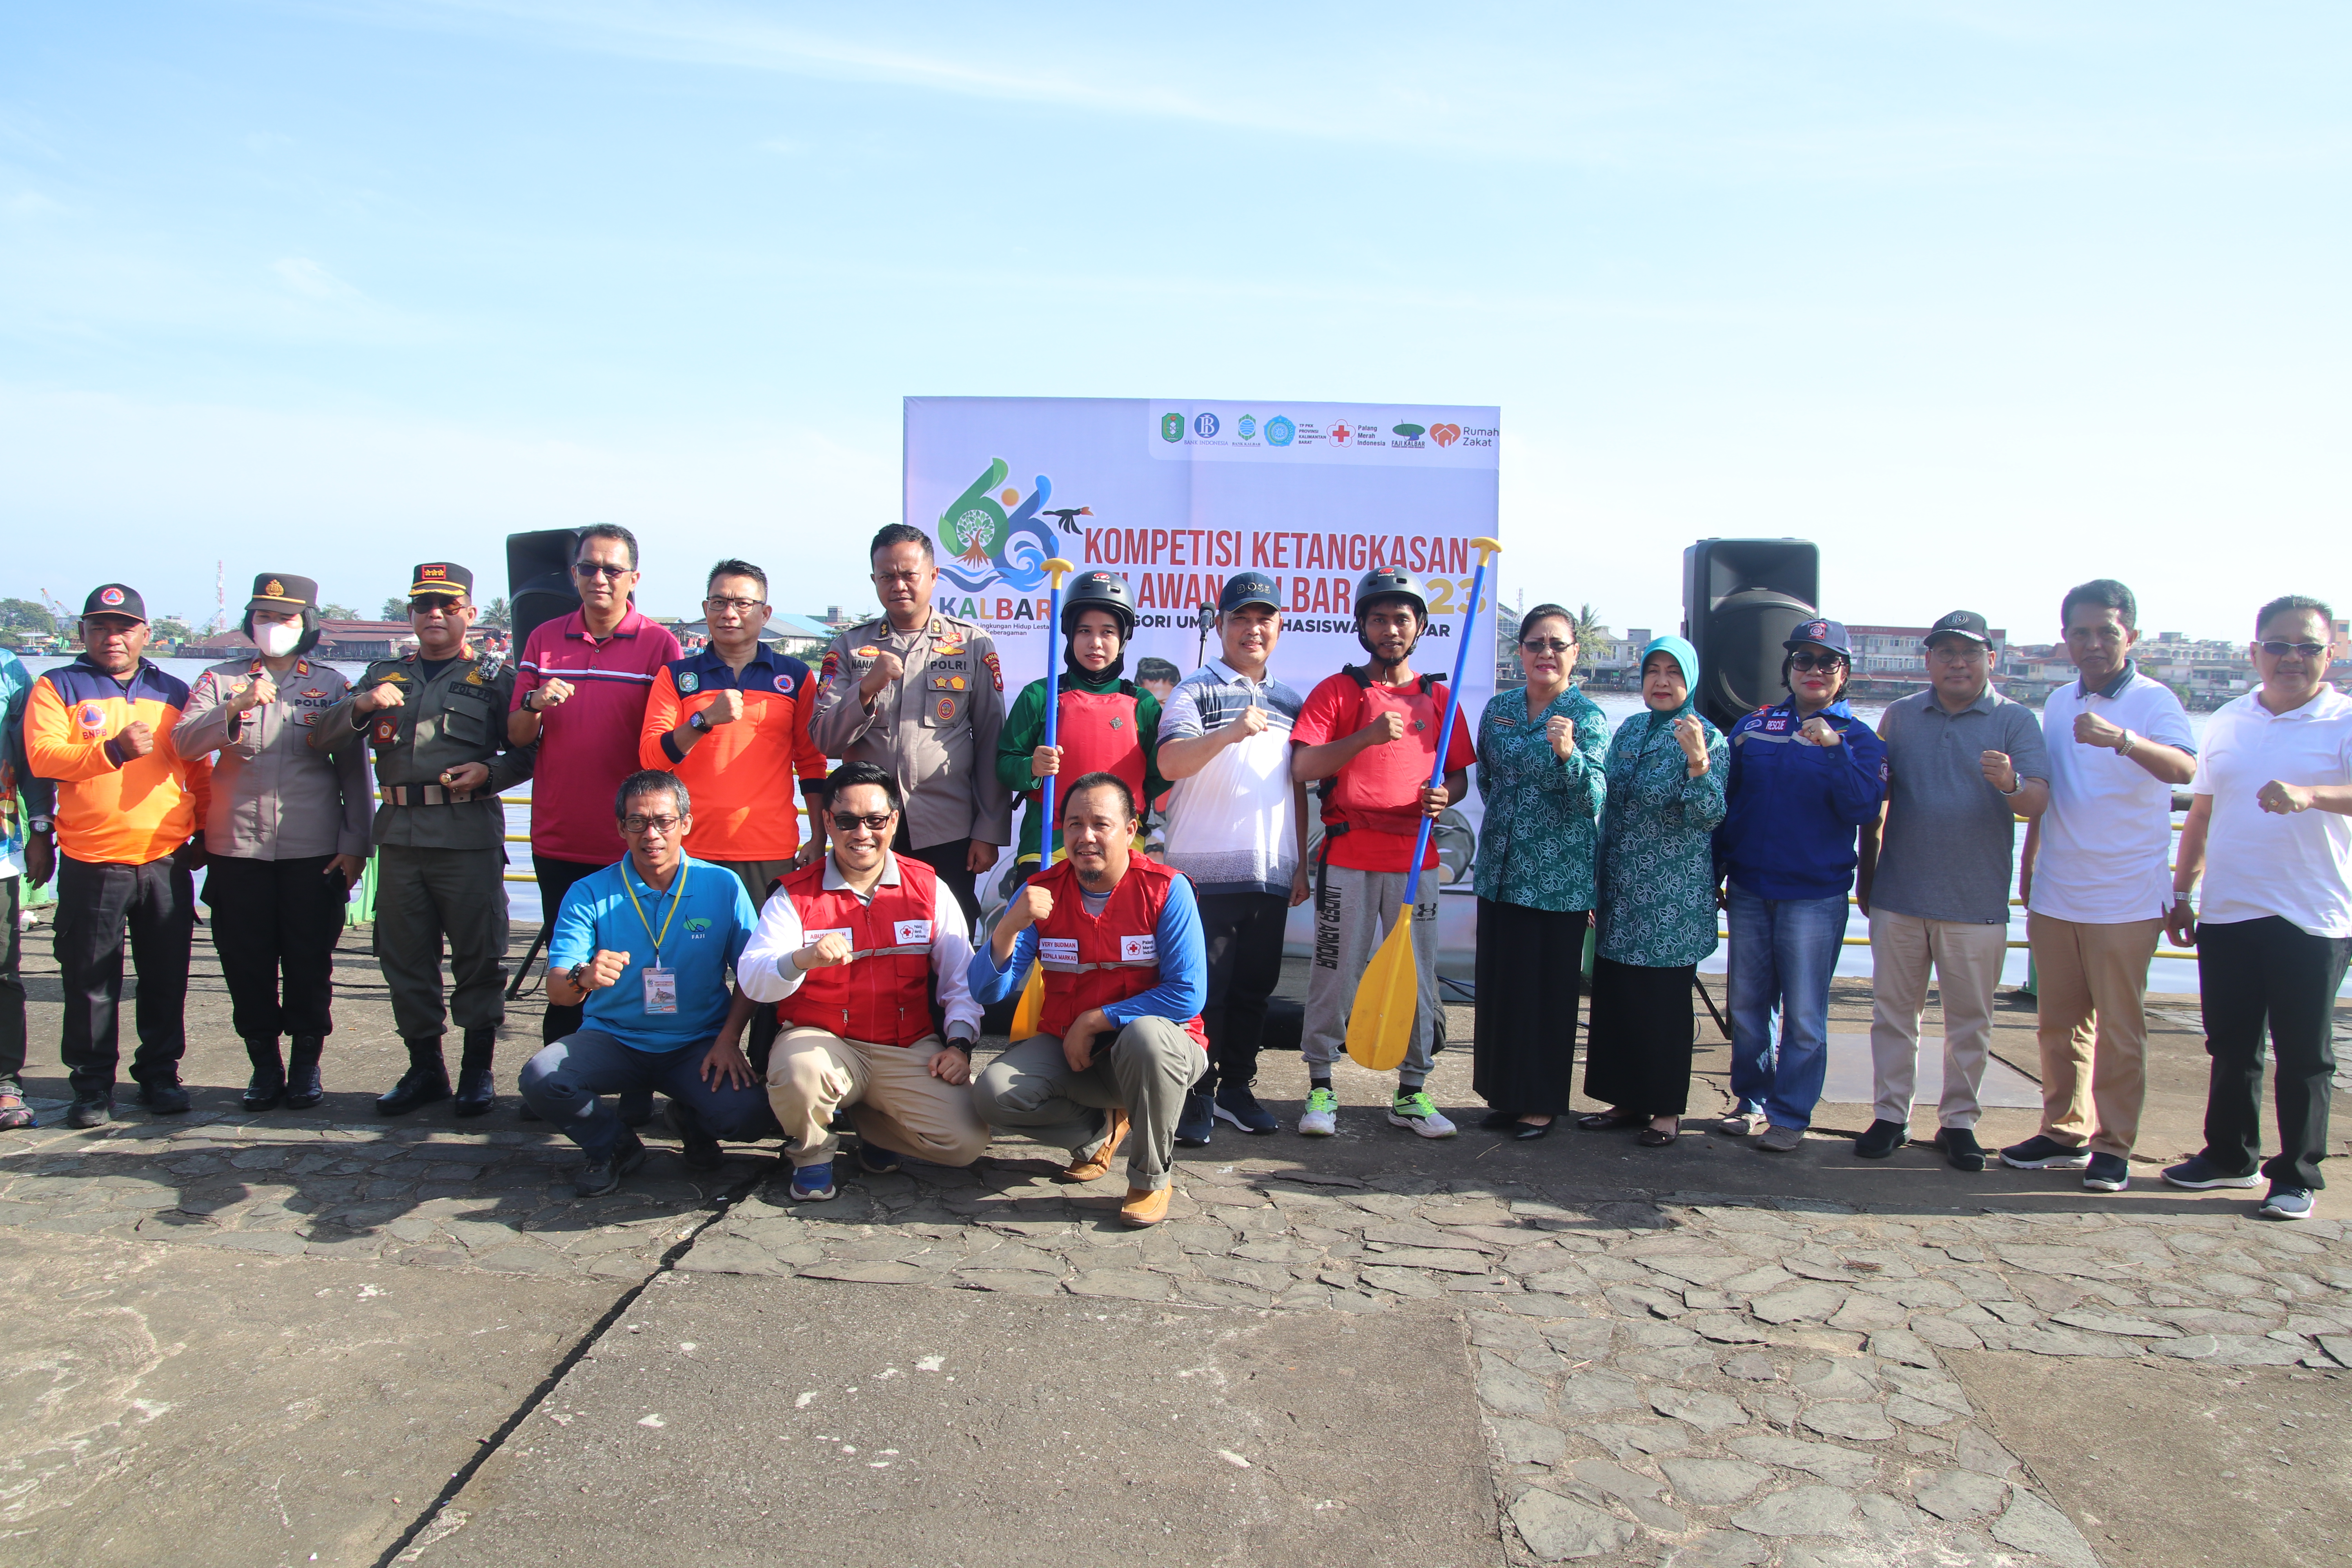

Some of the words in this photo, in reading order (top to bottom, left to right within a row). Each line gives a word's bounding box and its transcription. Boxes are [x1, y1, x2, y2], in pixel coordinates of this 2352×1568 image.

[1463, 427, 1499, 436] Rumah
[1463, 437, 1492, 446] Zakat
[1085, 528, 1240, 567] KOMPETISI
[1252, 531, 1468, 574] KETANGKASAN
[1237, 582, 1271, 594] BOSS
[939, 597, 1051, 621] KALBAR
[930, 661, 966, 670] POLRI
[452, 685, 472, 694] POL
[477, 690, 489, 698] PP
[295, 699, 332, 708] POLRI
[1766, 720, 1786, 730] RESCUE
[82, 729, 107, 740] BNPB
[1316, 921, 1339, 970] ARMOUR
